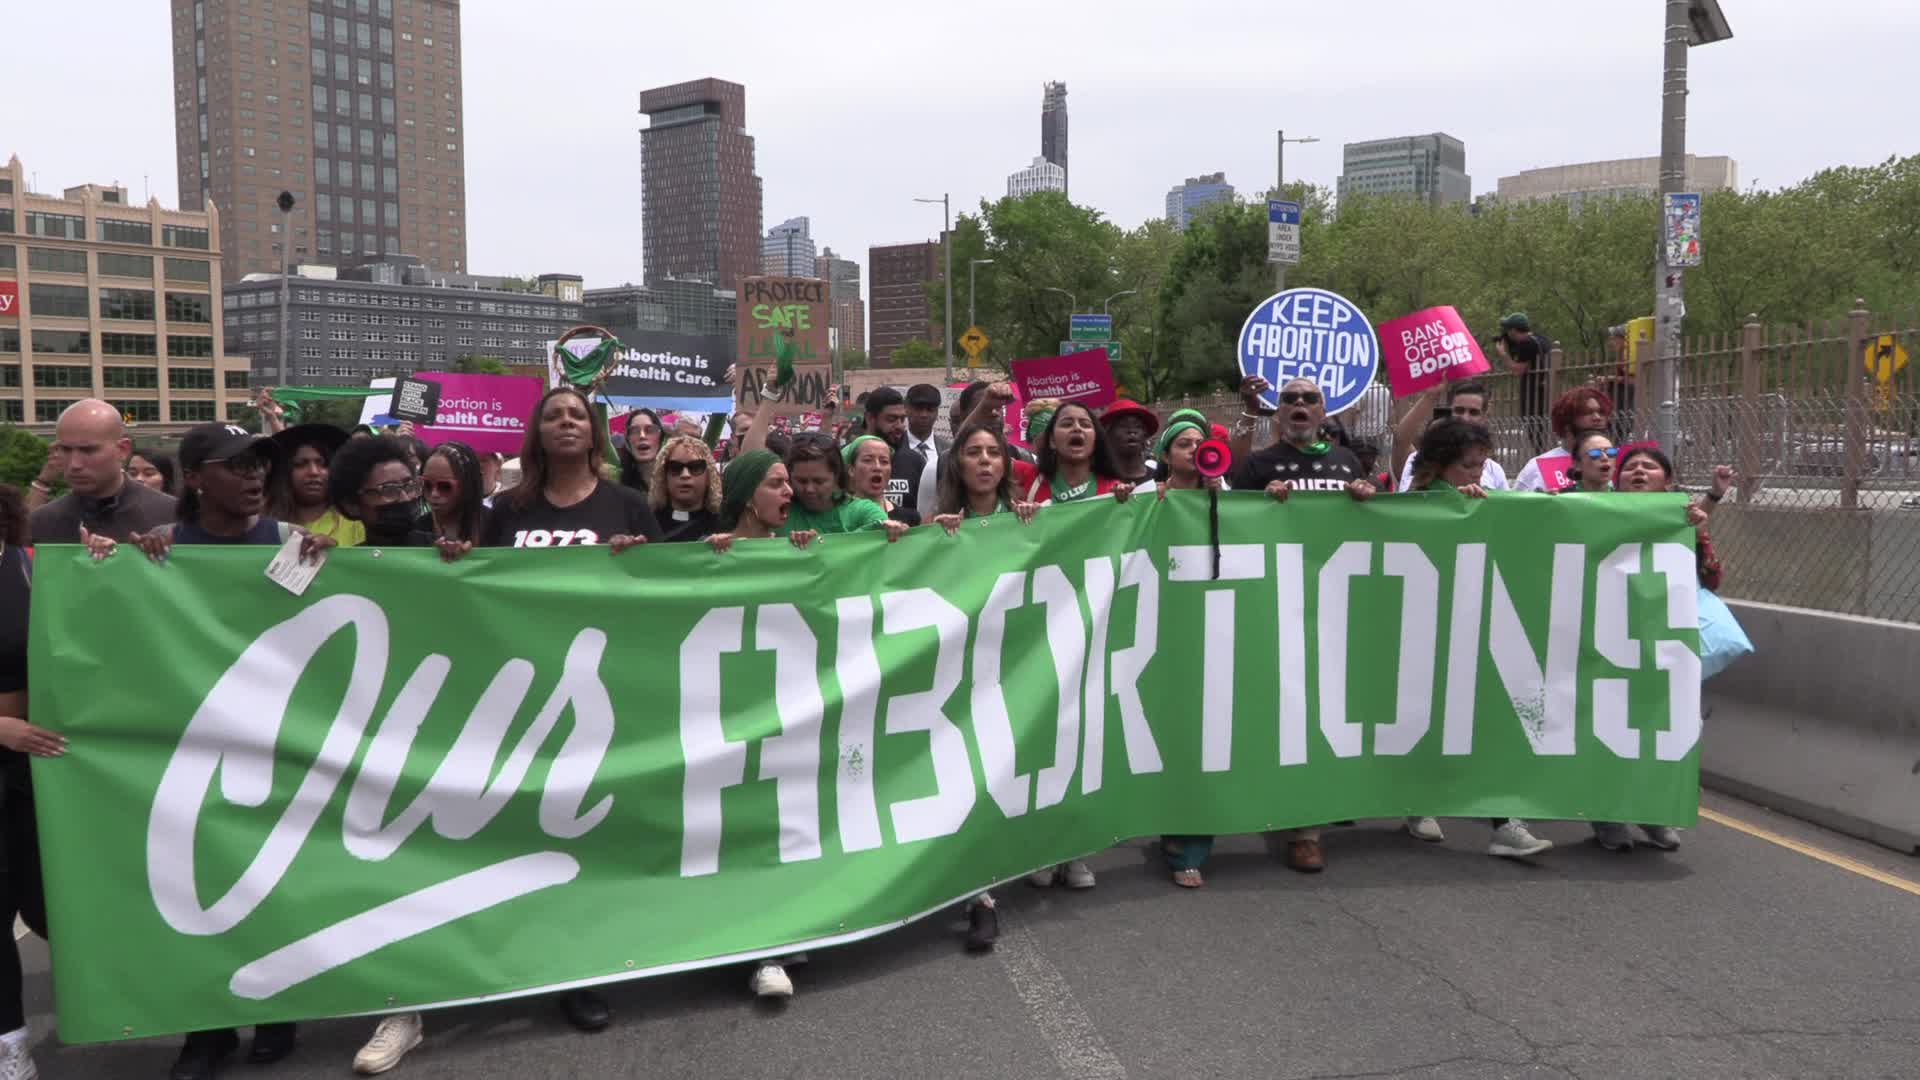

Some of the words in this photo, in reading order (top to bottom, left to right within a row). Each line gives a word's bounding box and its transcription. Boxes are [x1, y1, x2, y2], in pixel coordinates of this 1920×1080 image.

[743, 281, 823, 303] PROTECT
[752, 303, 813, 330] SAFE
[1271, 293, 1352, 329] KEEP
[1247, 322, 1370, 367] ABORTION
[1401, 319, 1447, 346] BANS
[1405, 338, 1440, 362] OFF
[1441, 331, 1469, 350] OUR
[695, 355, 708, 368] is
[1408, 347, 1473, 378] BODIES
[674, 370, 716, 386] Care.
[1027, 375, 1068, 386] Abortion
[1071, 372, 1080, 382] is
[1029, 385, 1065, 397] Health
[1067, 380, 1100, 394] Care.
[493, 398, 503, 411] is
[436, 411, 478, 425] ealth
[482, 413, 524, 428] Care.
[146, 593, 615, 936] Our
[680, 541, 1704, 878] ABORTIONS
